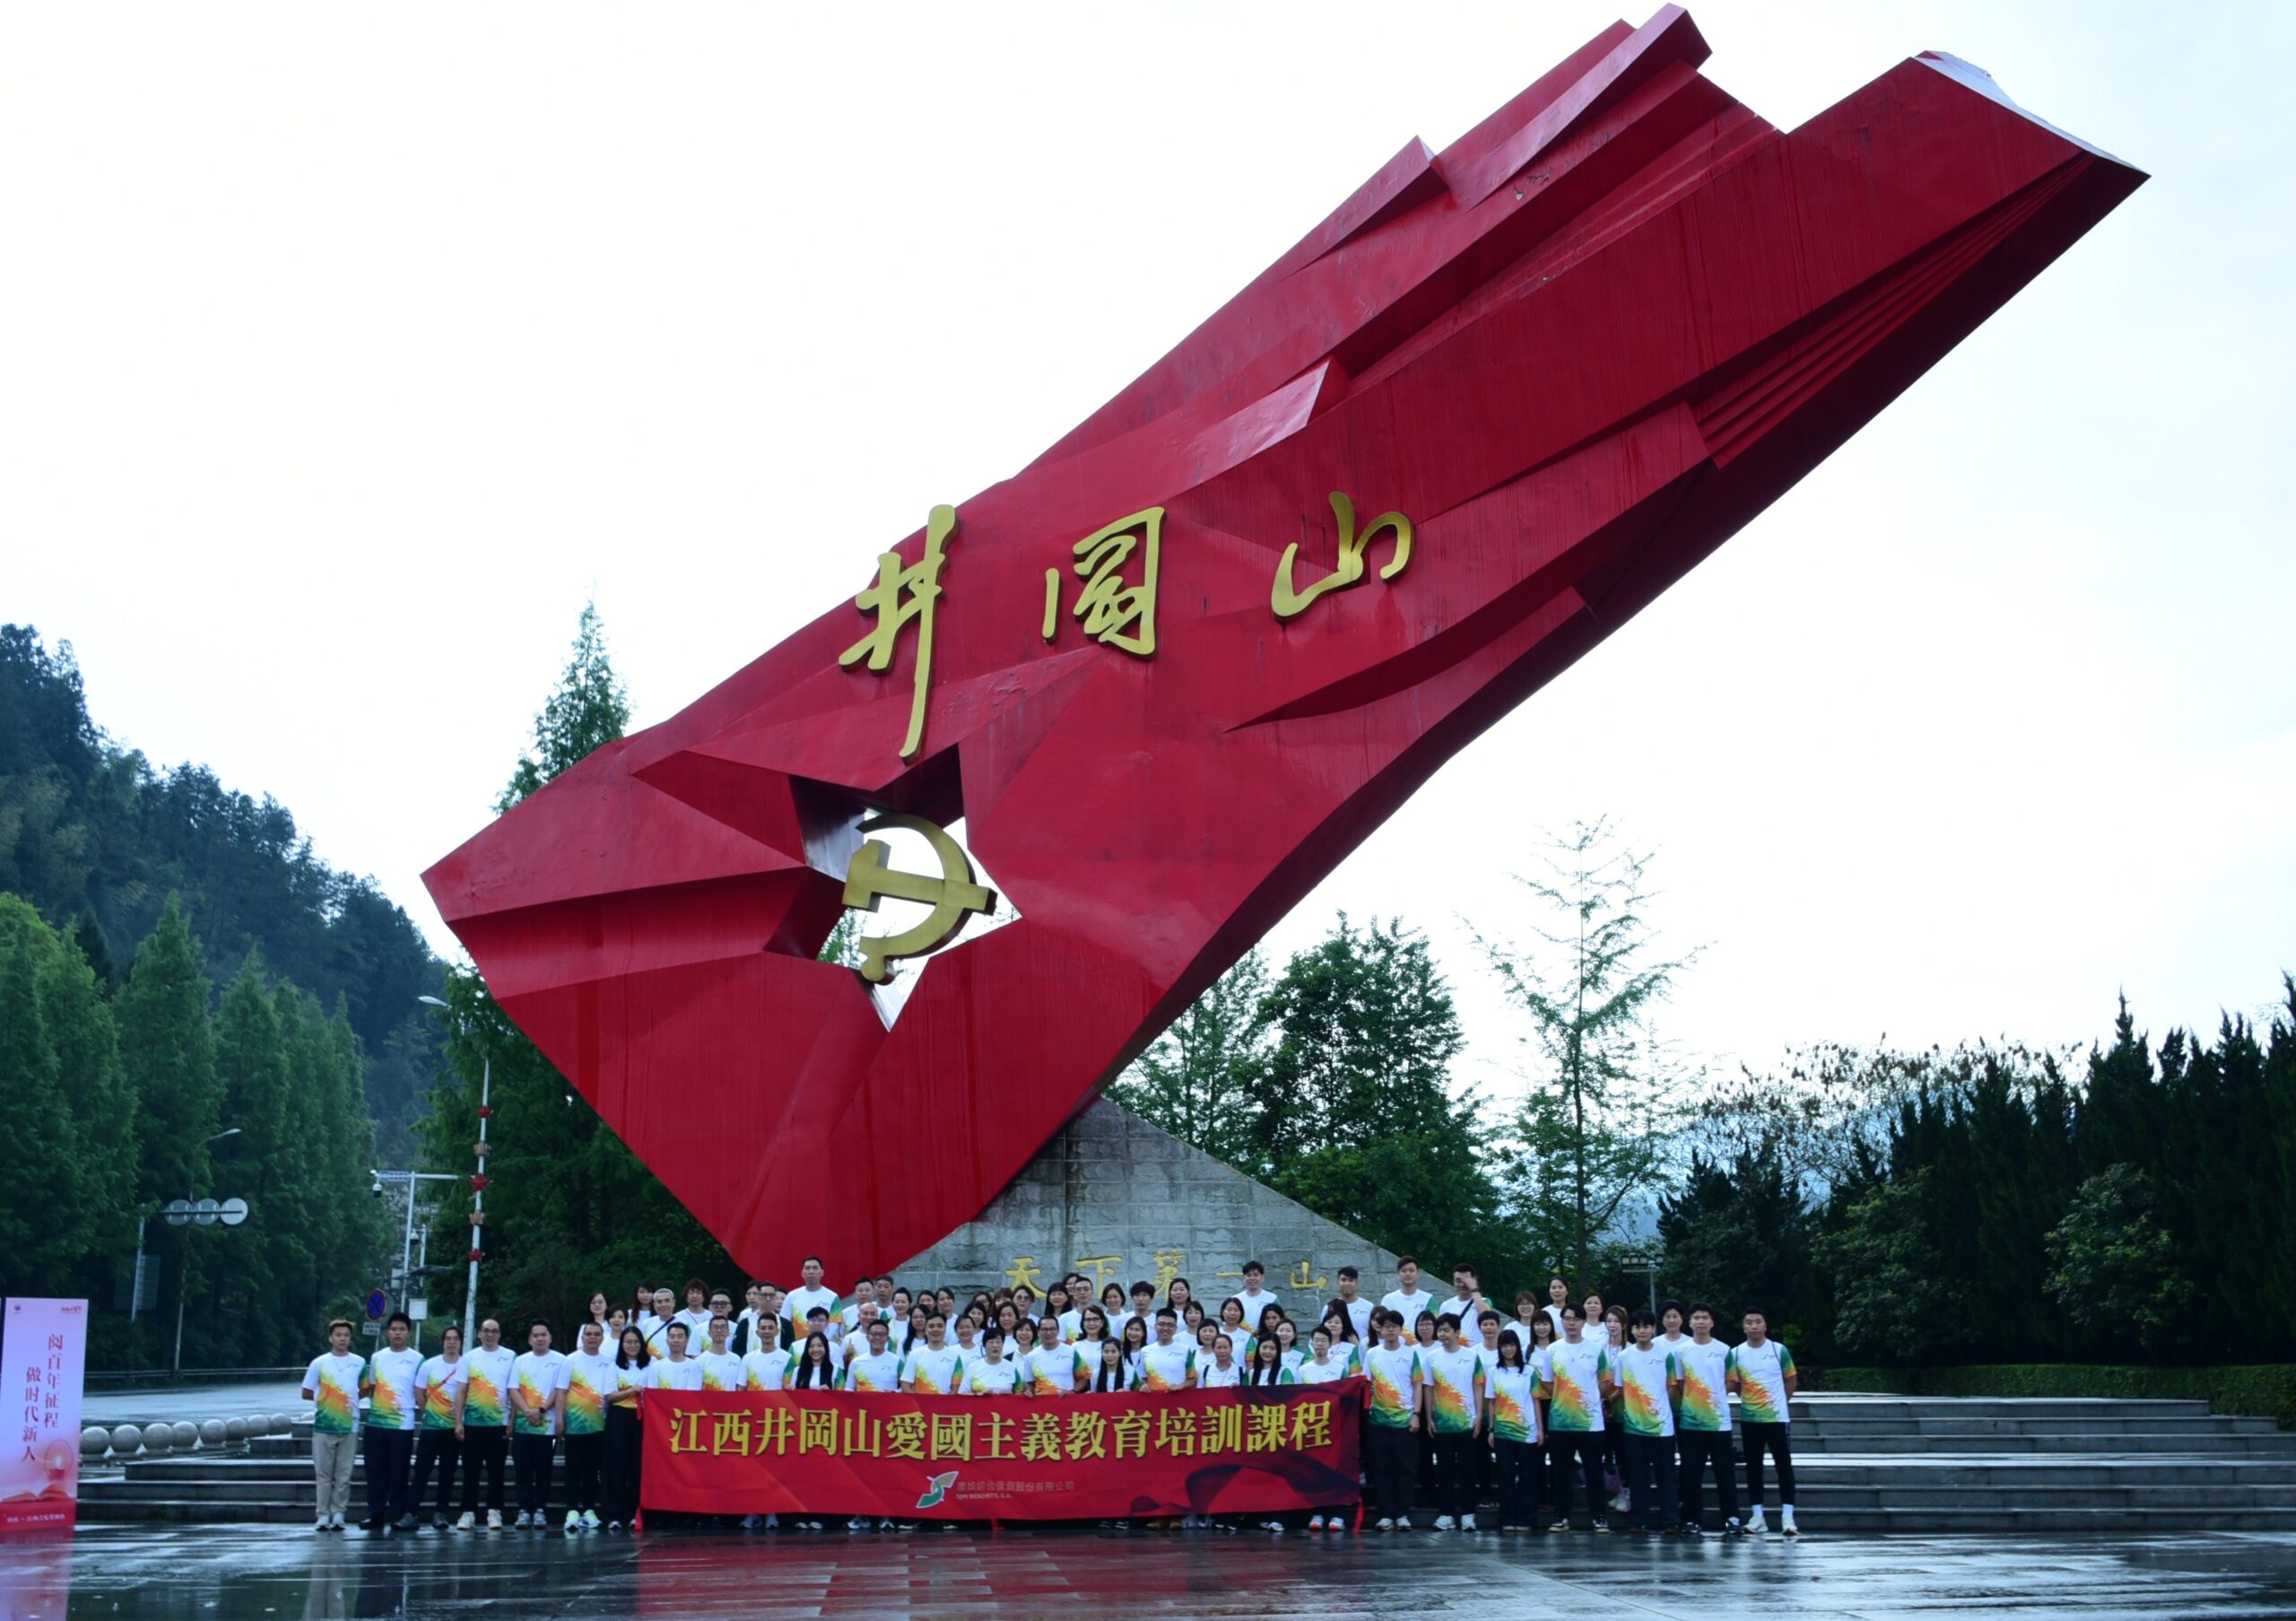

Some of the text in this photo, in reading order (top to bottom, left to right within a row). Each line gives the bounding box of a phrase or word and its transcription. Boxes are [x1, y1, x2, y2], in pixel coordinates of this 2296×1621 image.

[22, 1366, 41, 1462] 做时代新人
[45, 1334, 64, 1428] 阅百年征程
[670, 1399, 1333, 1461] 江西井岡山愛國主義教育培訓課程
